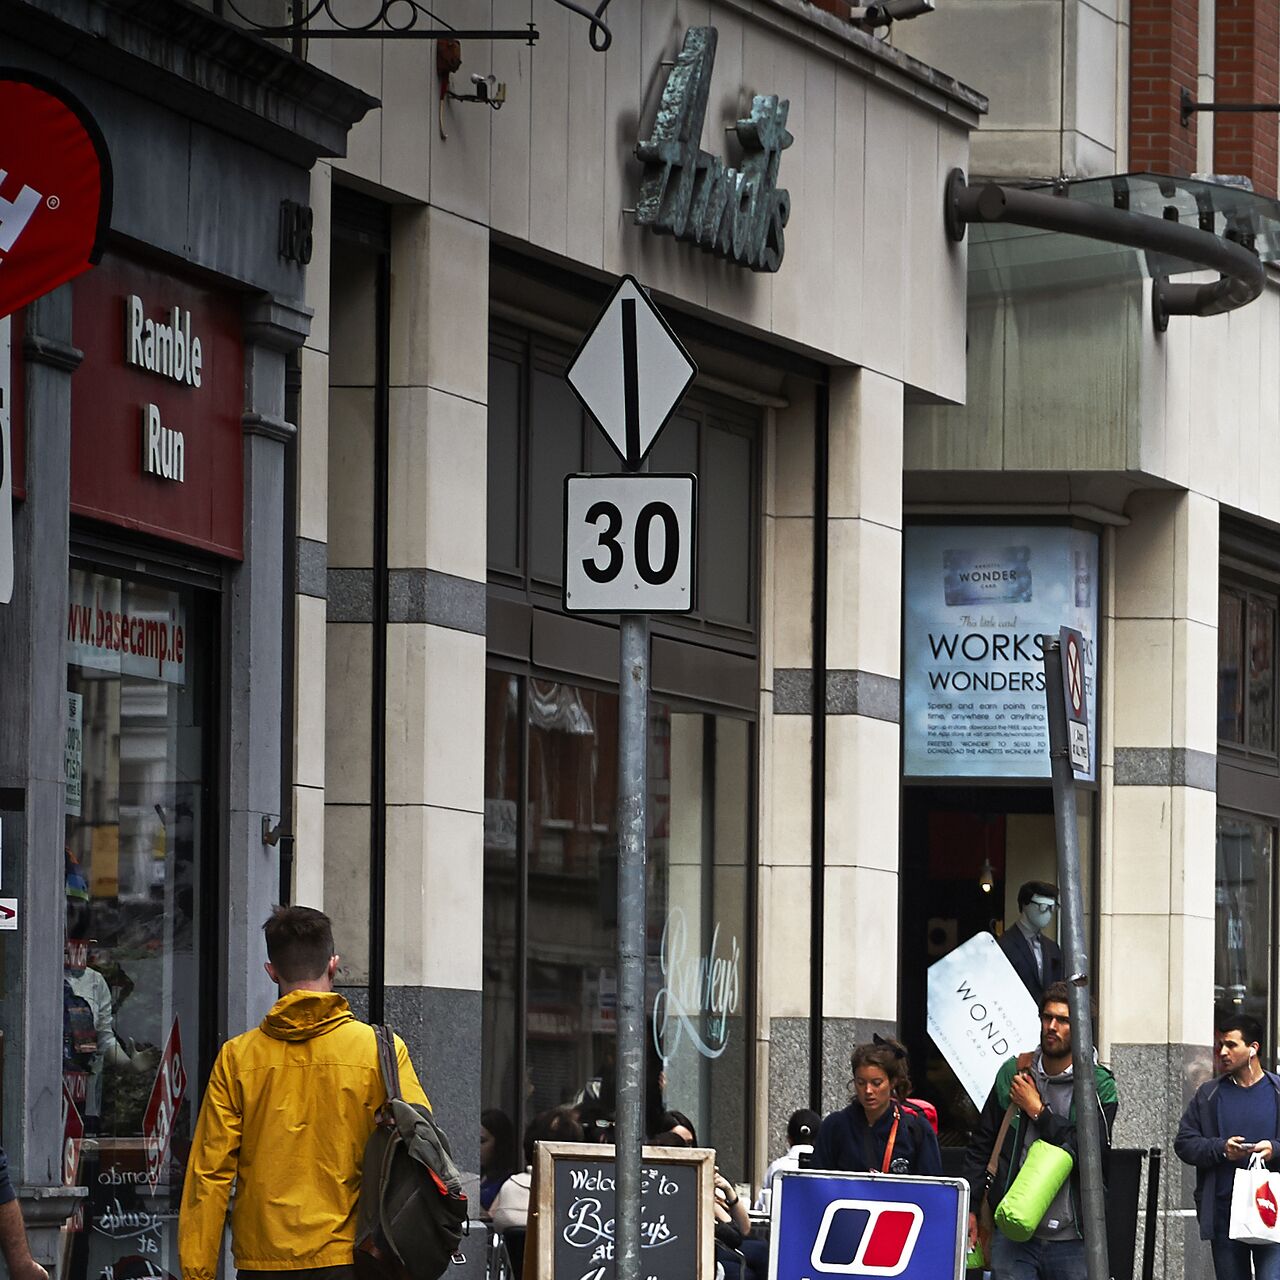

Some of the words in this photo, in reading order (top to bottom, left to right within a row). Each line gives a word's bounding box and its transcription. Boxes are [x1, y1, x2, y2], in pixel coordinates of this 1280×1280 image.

[128, 295, 202, 388] Ramble
[144, 402, 184, 483] Run
[582, 501, 679, 586] 30
[959, 570, 1017, 582] WONDER
[928, 633, 1045, 662] WORKS
[928, 671, 1046, 691] WONDERS
[928, 702, 952, 711] Spend
[958, 702, 974, 710] and
[1003, 703, 1025, 711] points
[952, 713, 989, 721] anywhere
[659, 1175, 679, 1195] to
[592, 1243, 614, 1262] at
